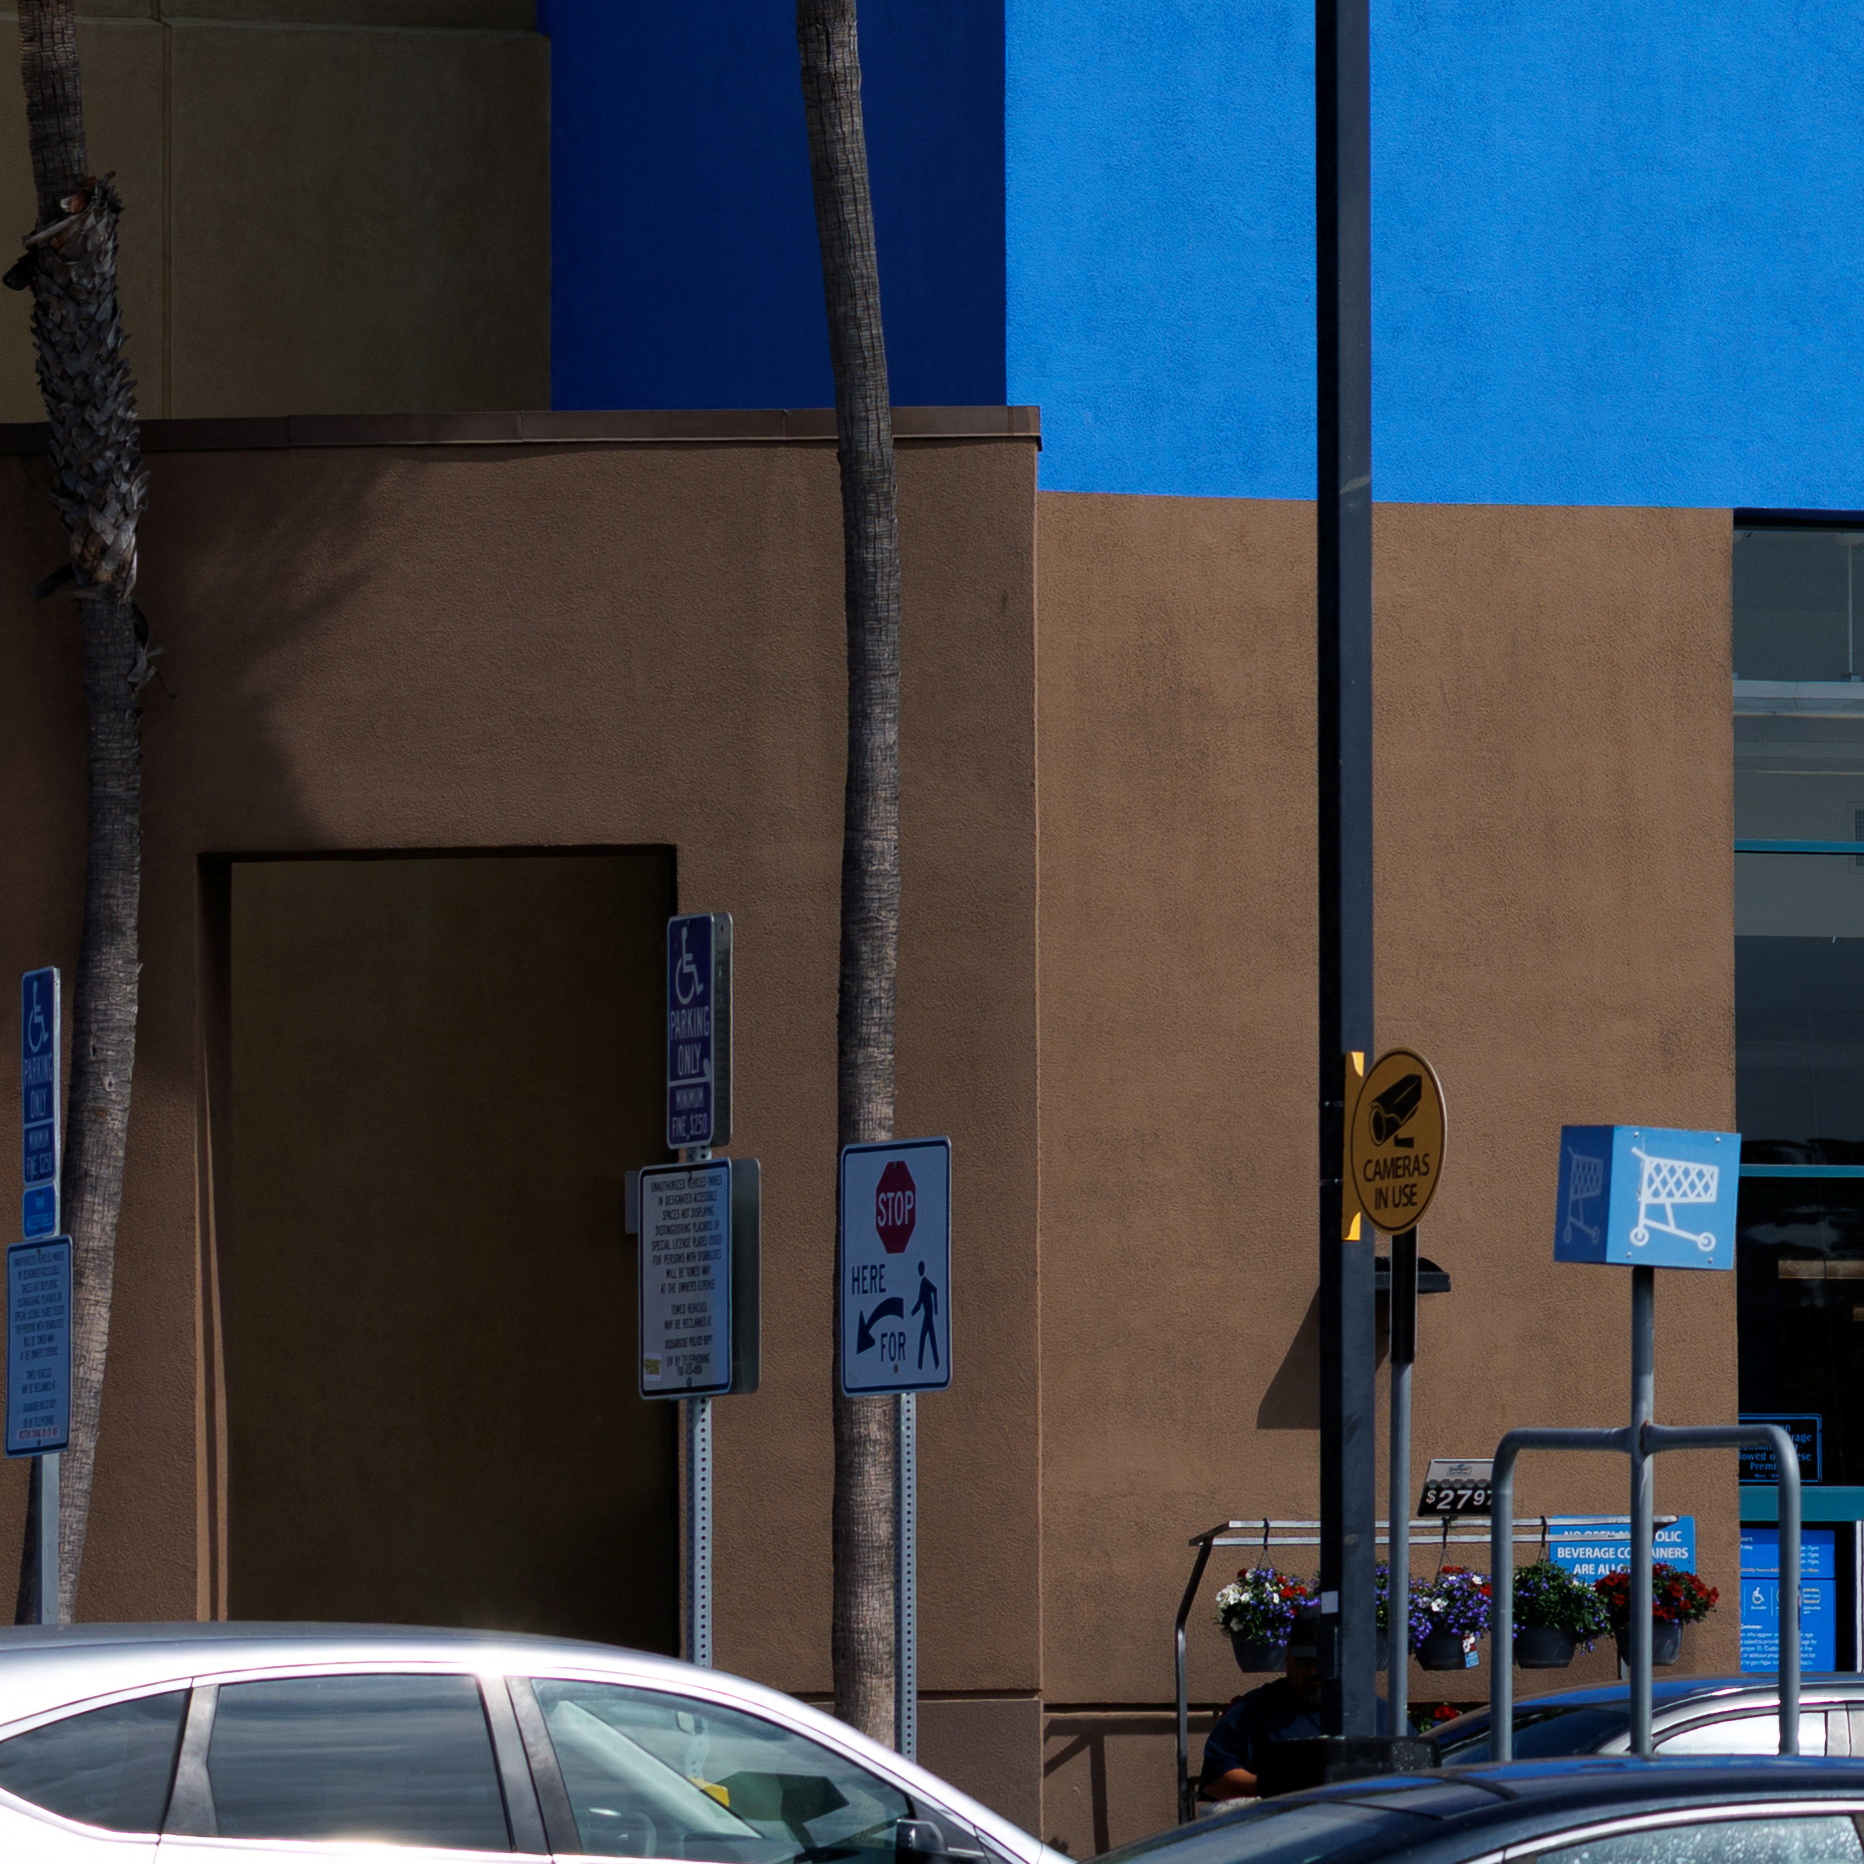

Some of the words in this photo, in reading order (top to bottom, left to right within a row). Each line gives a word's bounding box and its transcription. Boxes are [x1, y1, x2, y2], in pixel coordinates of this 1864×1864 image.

[670, 1005, 710, 1040] PARKING
[24, 1053, 53, 1087] PARKING
[677, 1043, 702, 1076] ONLY
[30, 1089, 47, 1119] ONLY
[672, 1116, 687, 1137] FINE
[689, 1112, 708, 1135] $250
[1363, 1152, 1430, 1182] CAMERAS
[877, 1190, 914, 1227] STOP
[1374, 1186, 1388, 1210] IN
[1392, 1183, 1417, 1208] USE
[851, 1263, 887, 1295] HERE
[880, 1331, 906, 1362] FOR
[1557, 1547, 1615, 1559] BEVERAGE
[1617, 1547, 1689, 1559] COINERS
[1573, 1563, 1596, 1575] ARE
